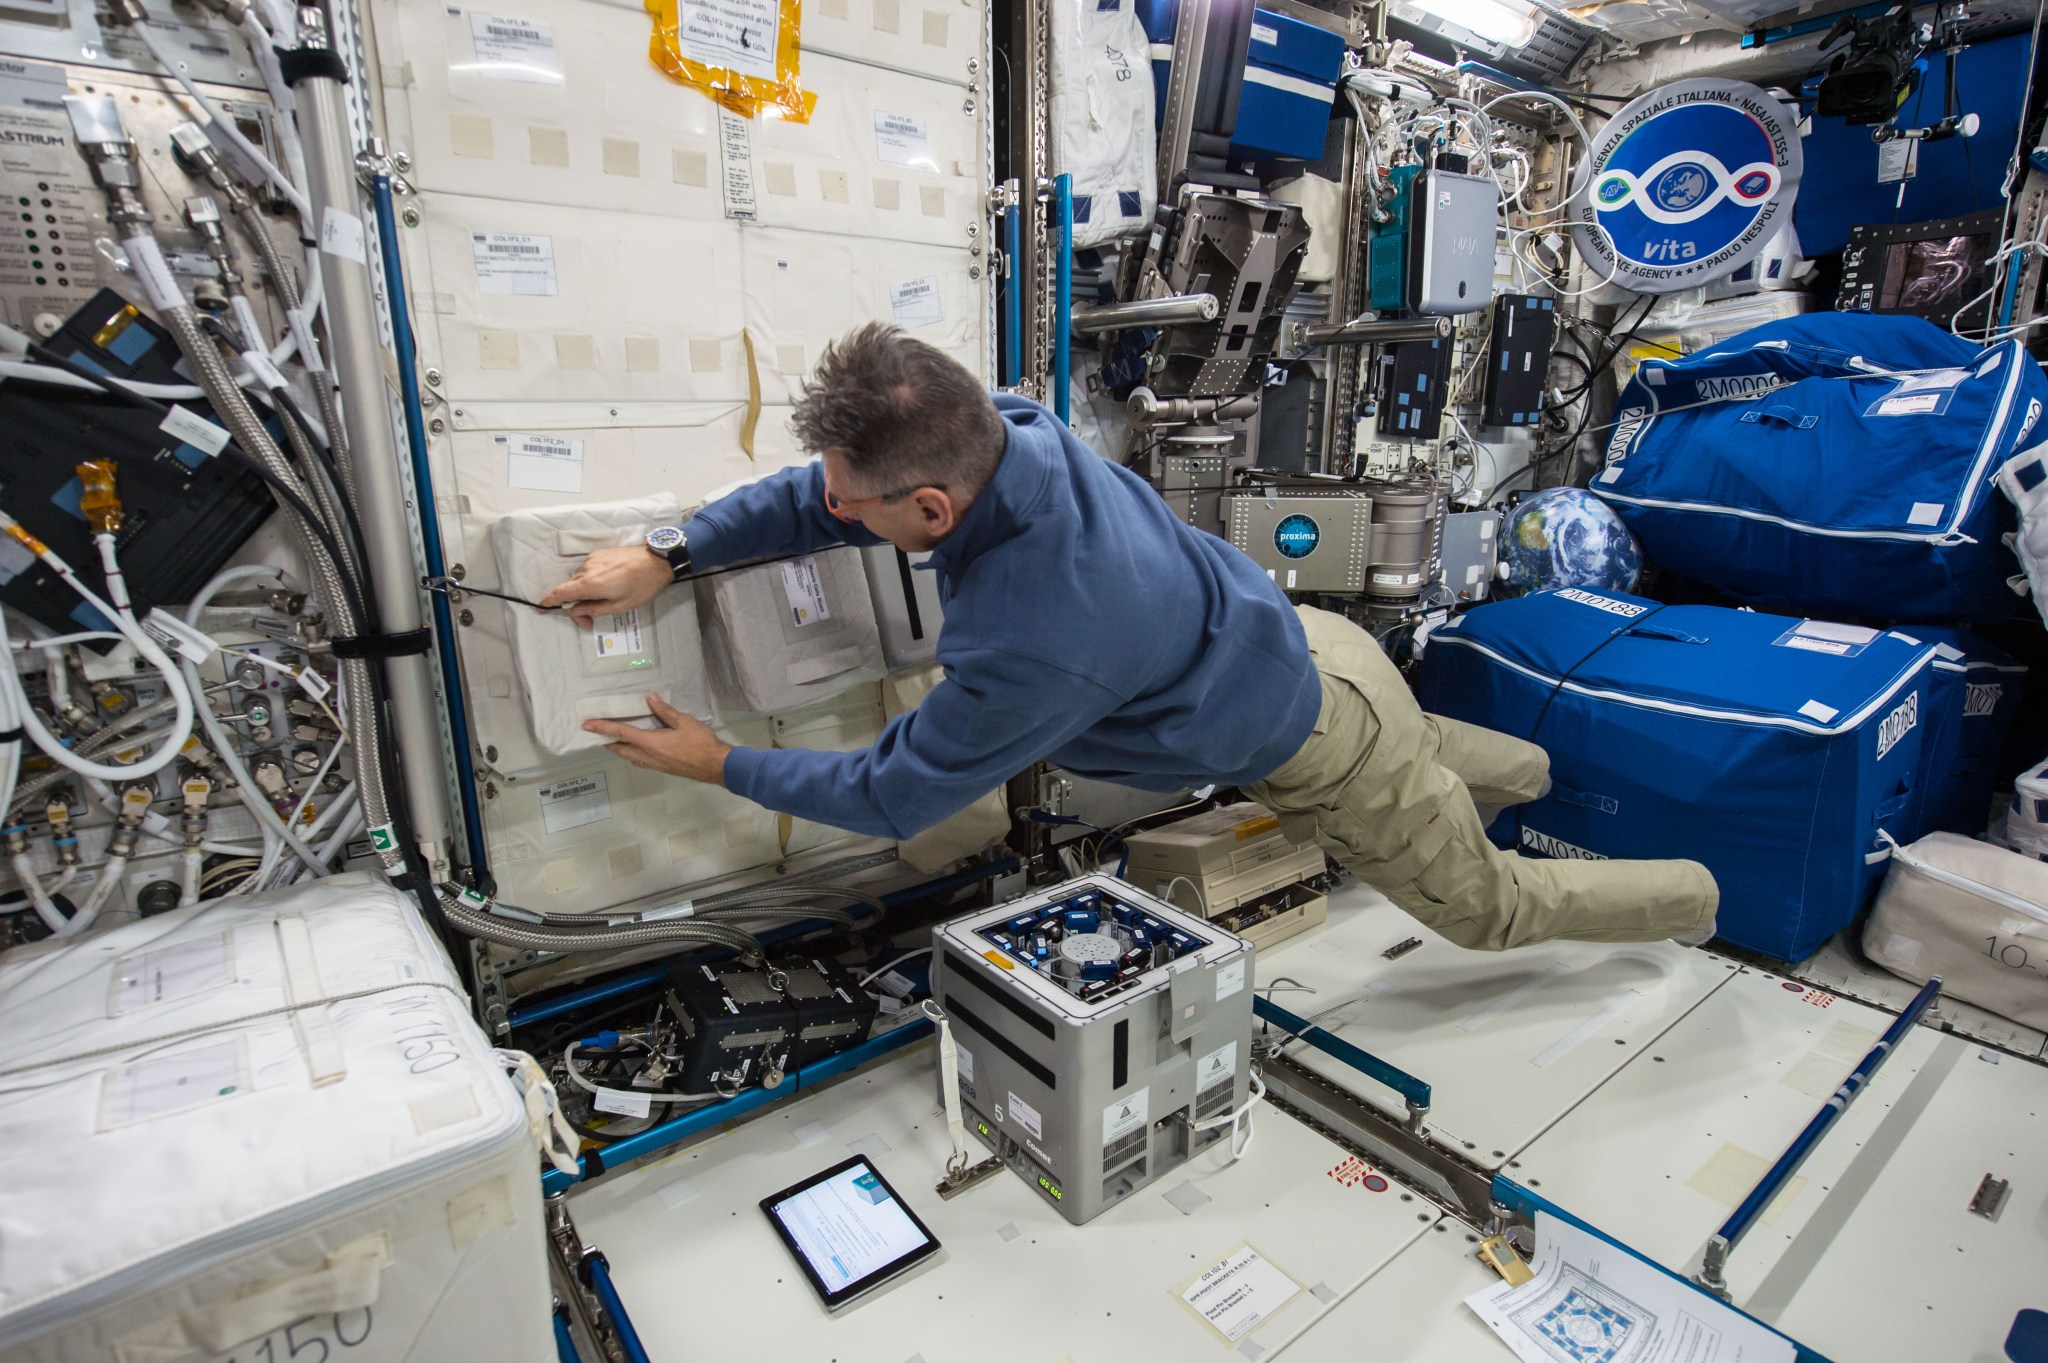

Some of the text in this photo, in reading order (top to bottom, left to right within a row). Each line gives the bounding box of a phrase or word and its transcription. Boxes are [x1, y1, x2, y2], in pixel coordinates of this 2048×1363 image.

[688, 25, 715, 38] damage
[1104, 44, 1132, 82] 4078
[1593, 133, 1624, 176] AGENZIA
[1622, 97, 1674, 134] SPAZIALE
[1676, 90, 1731, 104] ITALIANA
[1740, 98, 1781, 136] NASA/ASI
[1630, 266, 1673, 280] AGENCY
[1706, 243, 1742, 268] PAOLO
[1740, 200, 1780, 244] NESPOLI
[1644, 238, 1696, 261] vita
[530, 436, 564, 445] COL1F2_D1
[1280, 530, 1316, 542] proxima
[1556, 589, 1643, 616] 2M0188
[959, 1078, 976, 1100] esa
[994, 1104, 1004, 1122] 5
[1200, 1285, 1213, 1295] PIVOT
[1212, 1269, 1235, 1287] BRACKETS
[1202, 1260, 1229, 1282] COL1D2_B1
[1205, 1307, 1216, 1316] Pivot
[1223, 1291, 1238, 1304] Bracket
[1210, 1311, 1221, 1321] Pivot
[1228, 1295, 1244, 1308] Bracket
